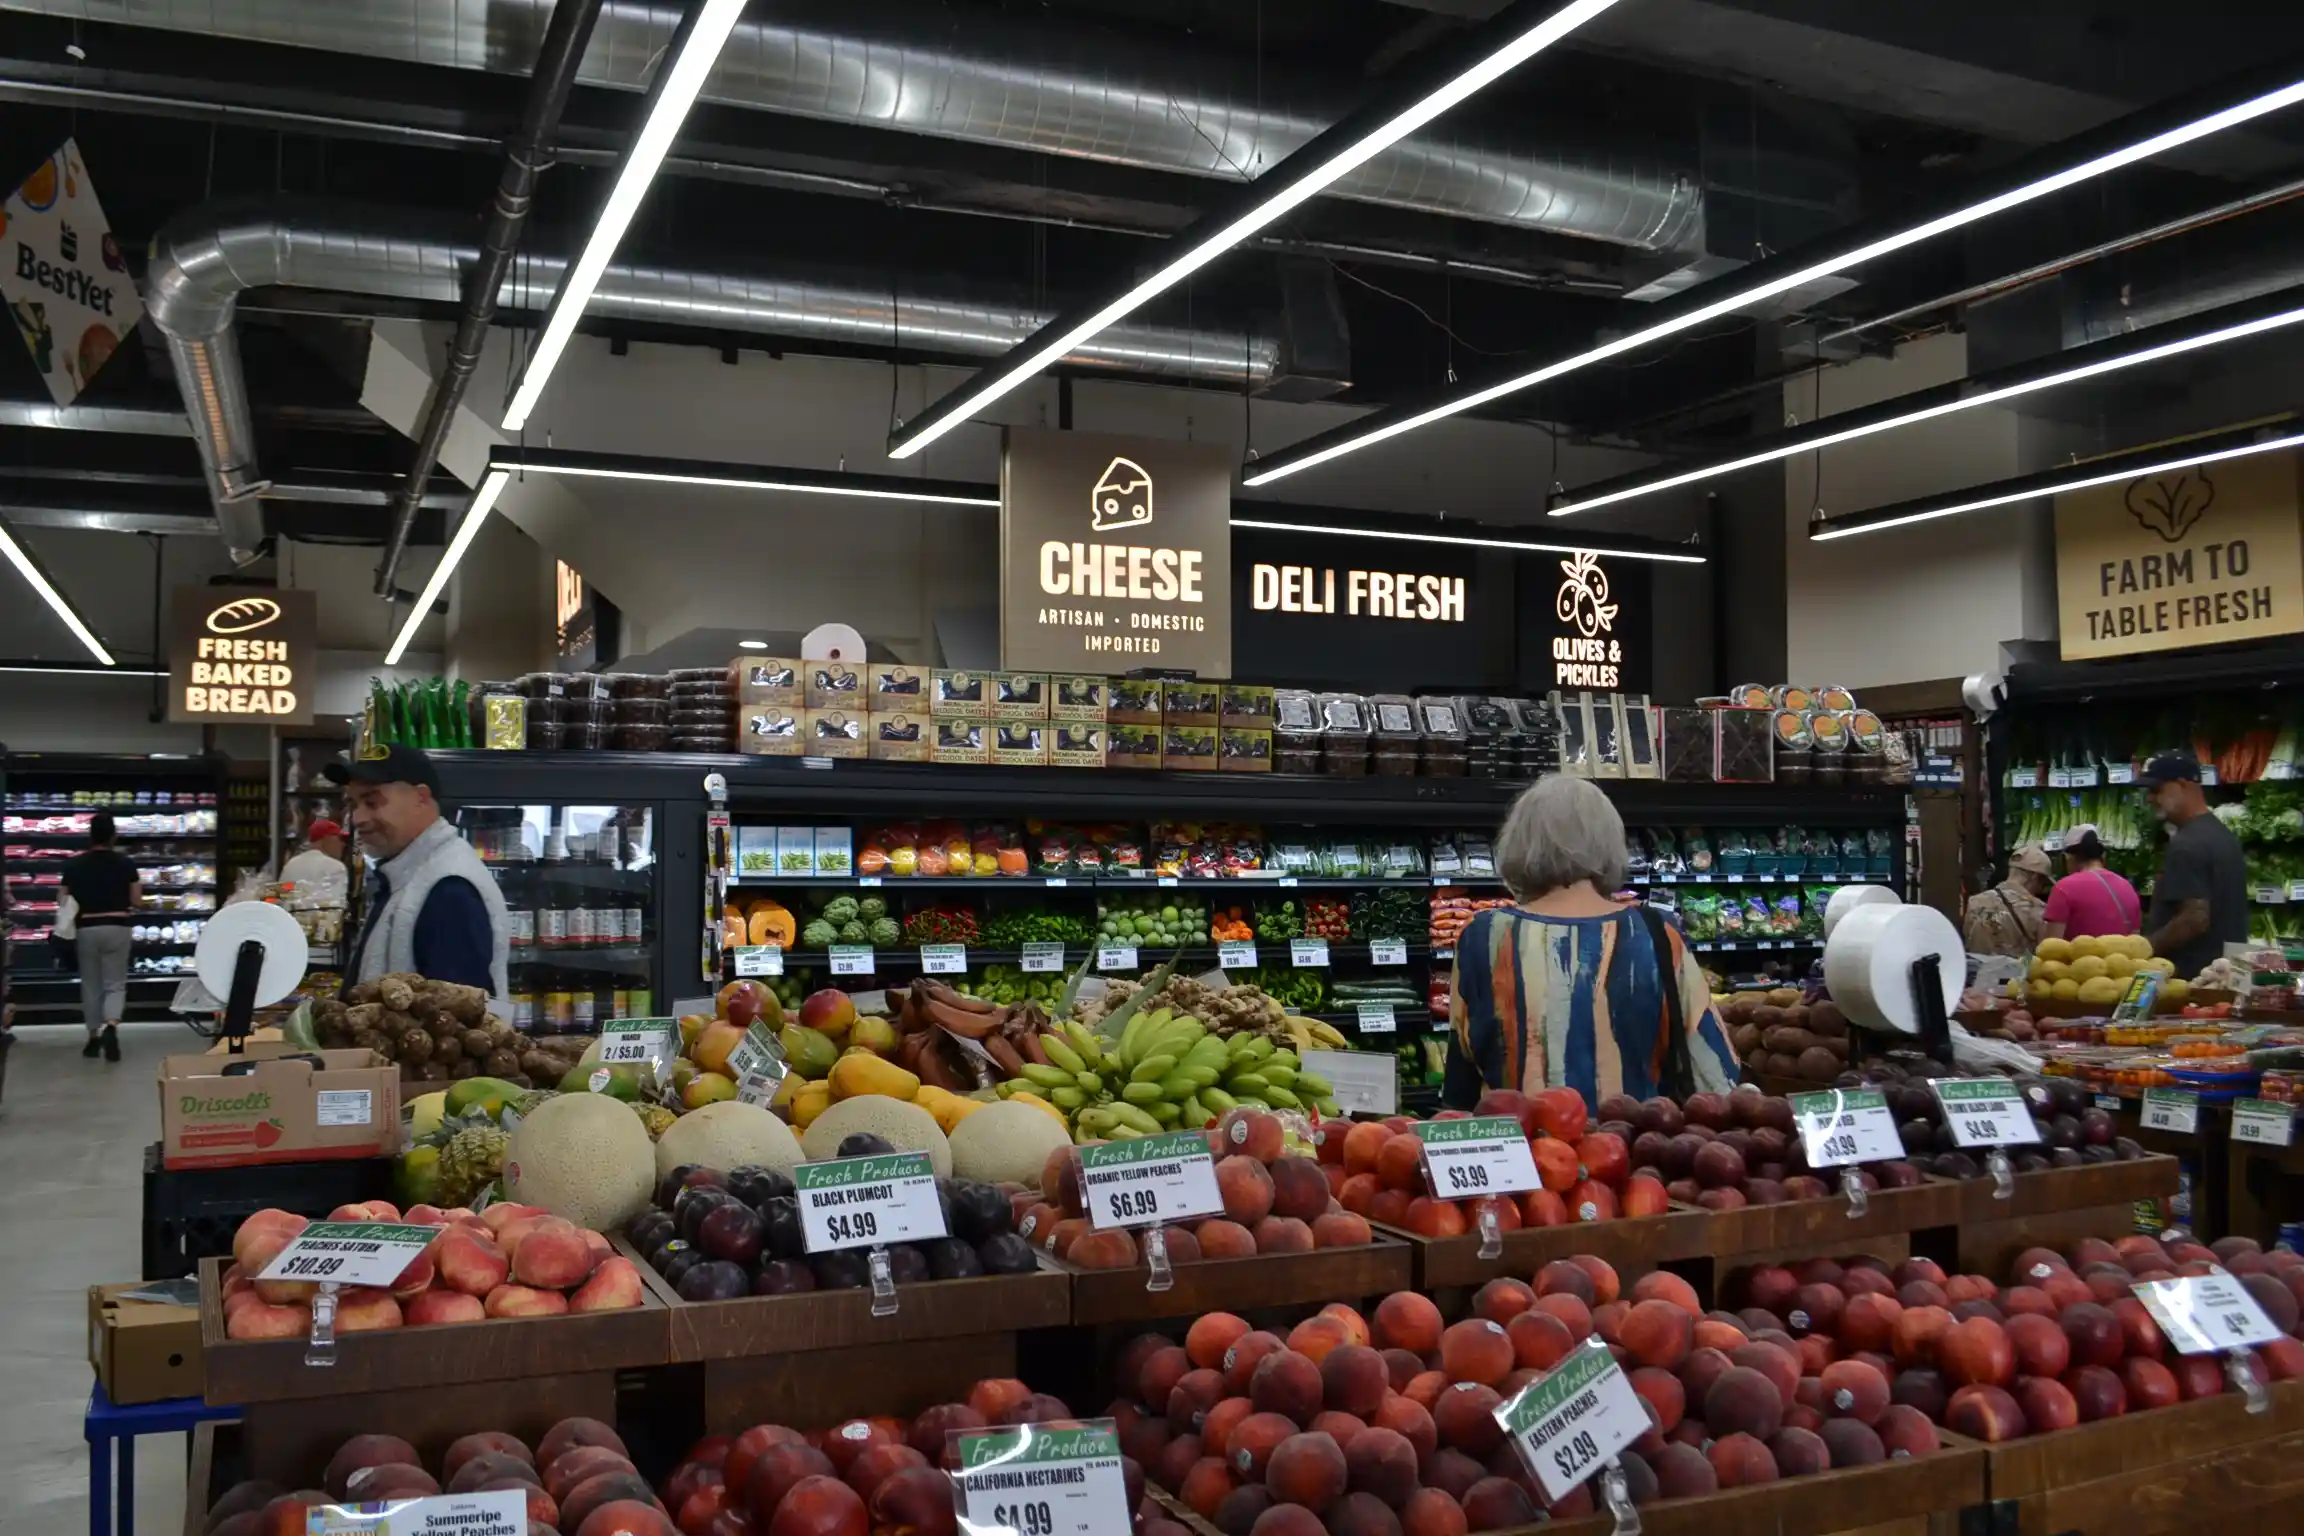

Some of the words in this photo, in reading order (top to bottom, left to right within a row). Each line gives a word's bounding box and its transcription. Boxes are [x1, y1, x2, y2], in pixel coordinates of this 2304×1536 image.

[16, 242, 113, 316] BestYet
[1040, 541, 1203, 602] CHEESE
[2101, 549, 2193, 598] FARM
[2204, 540, 2249, 581] TO
[1253, 564, 1335, 614] DELI
[1349, 571, 1465, 622] FRESH
[1038, 608, 1105, 627] ARTISAN
[1131, 614, 1205, 632] DOMESTIC
[2086, 601, 2169, 641] TABLE
[2178, 586, 2272, 629] FRESH
[199, 638, 287, 662] FRESH
[1085, 635, 1161, 654] IMPORTED
[1552, 637, 1606, 663] OLIVES
[1608, 641, 1622, 664] &
[191, 662, 292, 688] BAKED
[1556, 663, 1618, 688] PICKLES
[186, 688, 297, 714] BREAD
[604, 1046, 612, 1060] 2
[618, 1045, 645, 1059] $5.00
[181, 1091, 272, 1114] Driscoll's
[1427, 1124, 1464, 1141] Fresh
[1469, 1121, 1517, 1138] Produce
[1090, 1145, 1134, 1166] Fresh
[1141, 1137, 1200, 1160] Produce
[805, 1166, 853, 1188] Fresh
[861, 1159, 922, 1181] Produce
[1086, 1171, 1121, 1186] ORGANIC
[1120, 1167, 1149, 1181] YELLOW
[1150, 1163, 1182, 1177] PEACHES
[1448, 1165, 1489, 1190] $3.99
[811, 1190, 846, 1208] BLACK
[847, 1184, 894, 1204] PLUMCOT
[1109, 1190, 1158, 1220] $6.99
[309, 1224, 358, 1239] Fresh
[360, 1226, 423, 1241] Produce
[827, 1212, 877, 1243] $4.99
[295, 1240, 341, 1251] PEACHES
[339, 1241, 384, 1254] SATURN
[280, 1256, 345, 1276] $10.99
[1519, 1385, 1556, 1428] Fresh
[1557, 1356, 1605, 1396] Produce
[1527, 1414, 1567, 1452] EASTERN
[1562, 1388, 1600, 1426] PEACHES
[1036, 1431, 1108, 1459] Produce
[1553, 1430, 1600, 1480] $2.99
[966, 1471, 1025, 1493] CALIFORNIA
[1026, 1466, 1085, 1488] NECTARINES
[425, 1509, 502, 1528] Summeripe
[461, 1523, 517, 1536] Peaches
[994, 1500, 1053, 1536] $4.99
